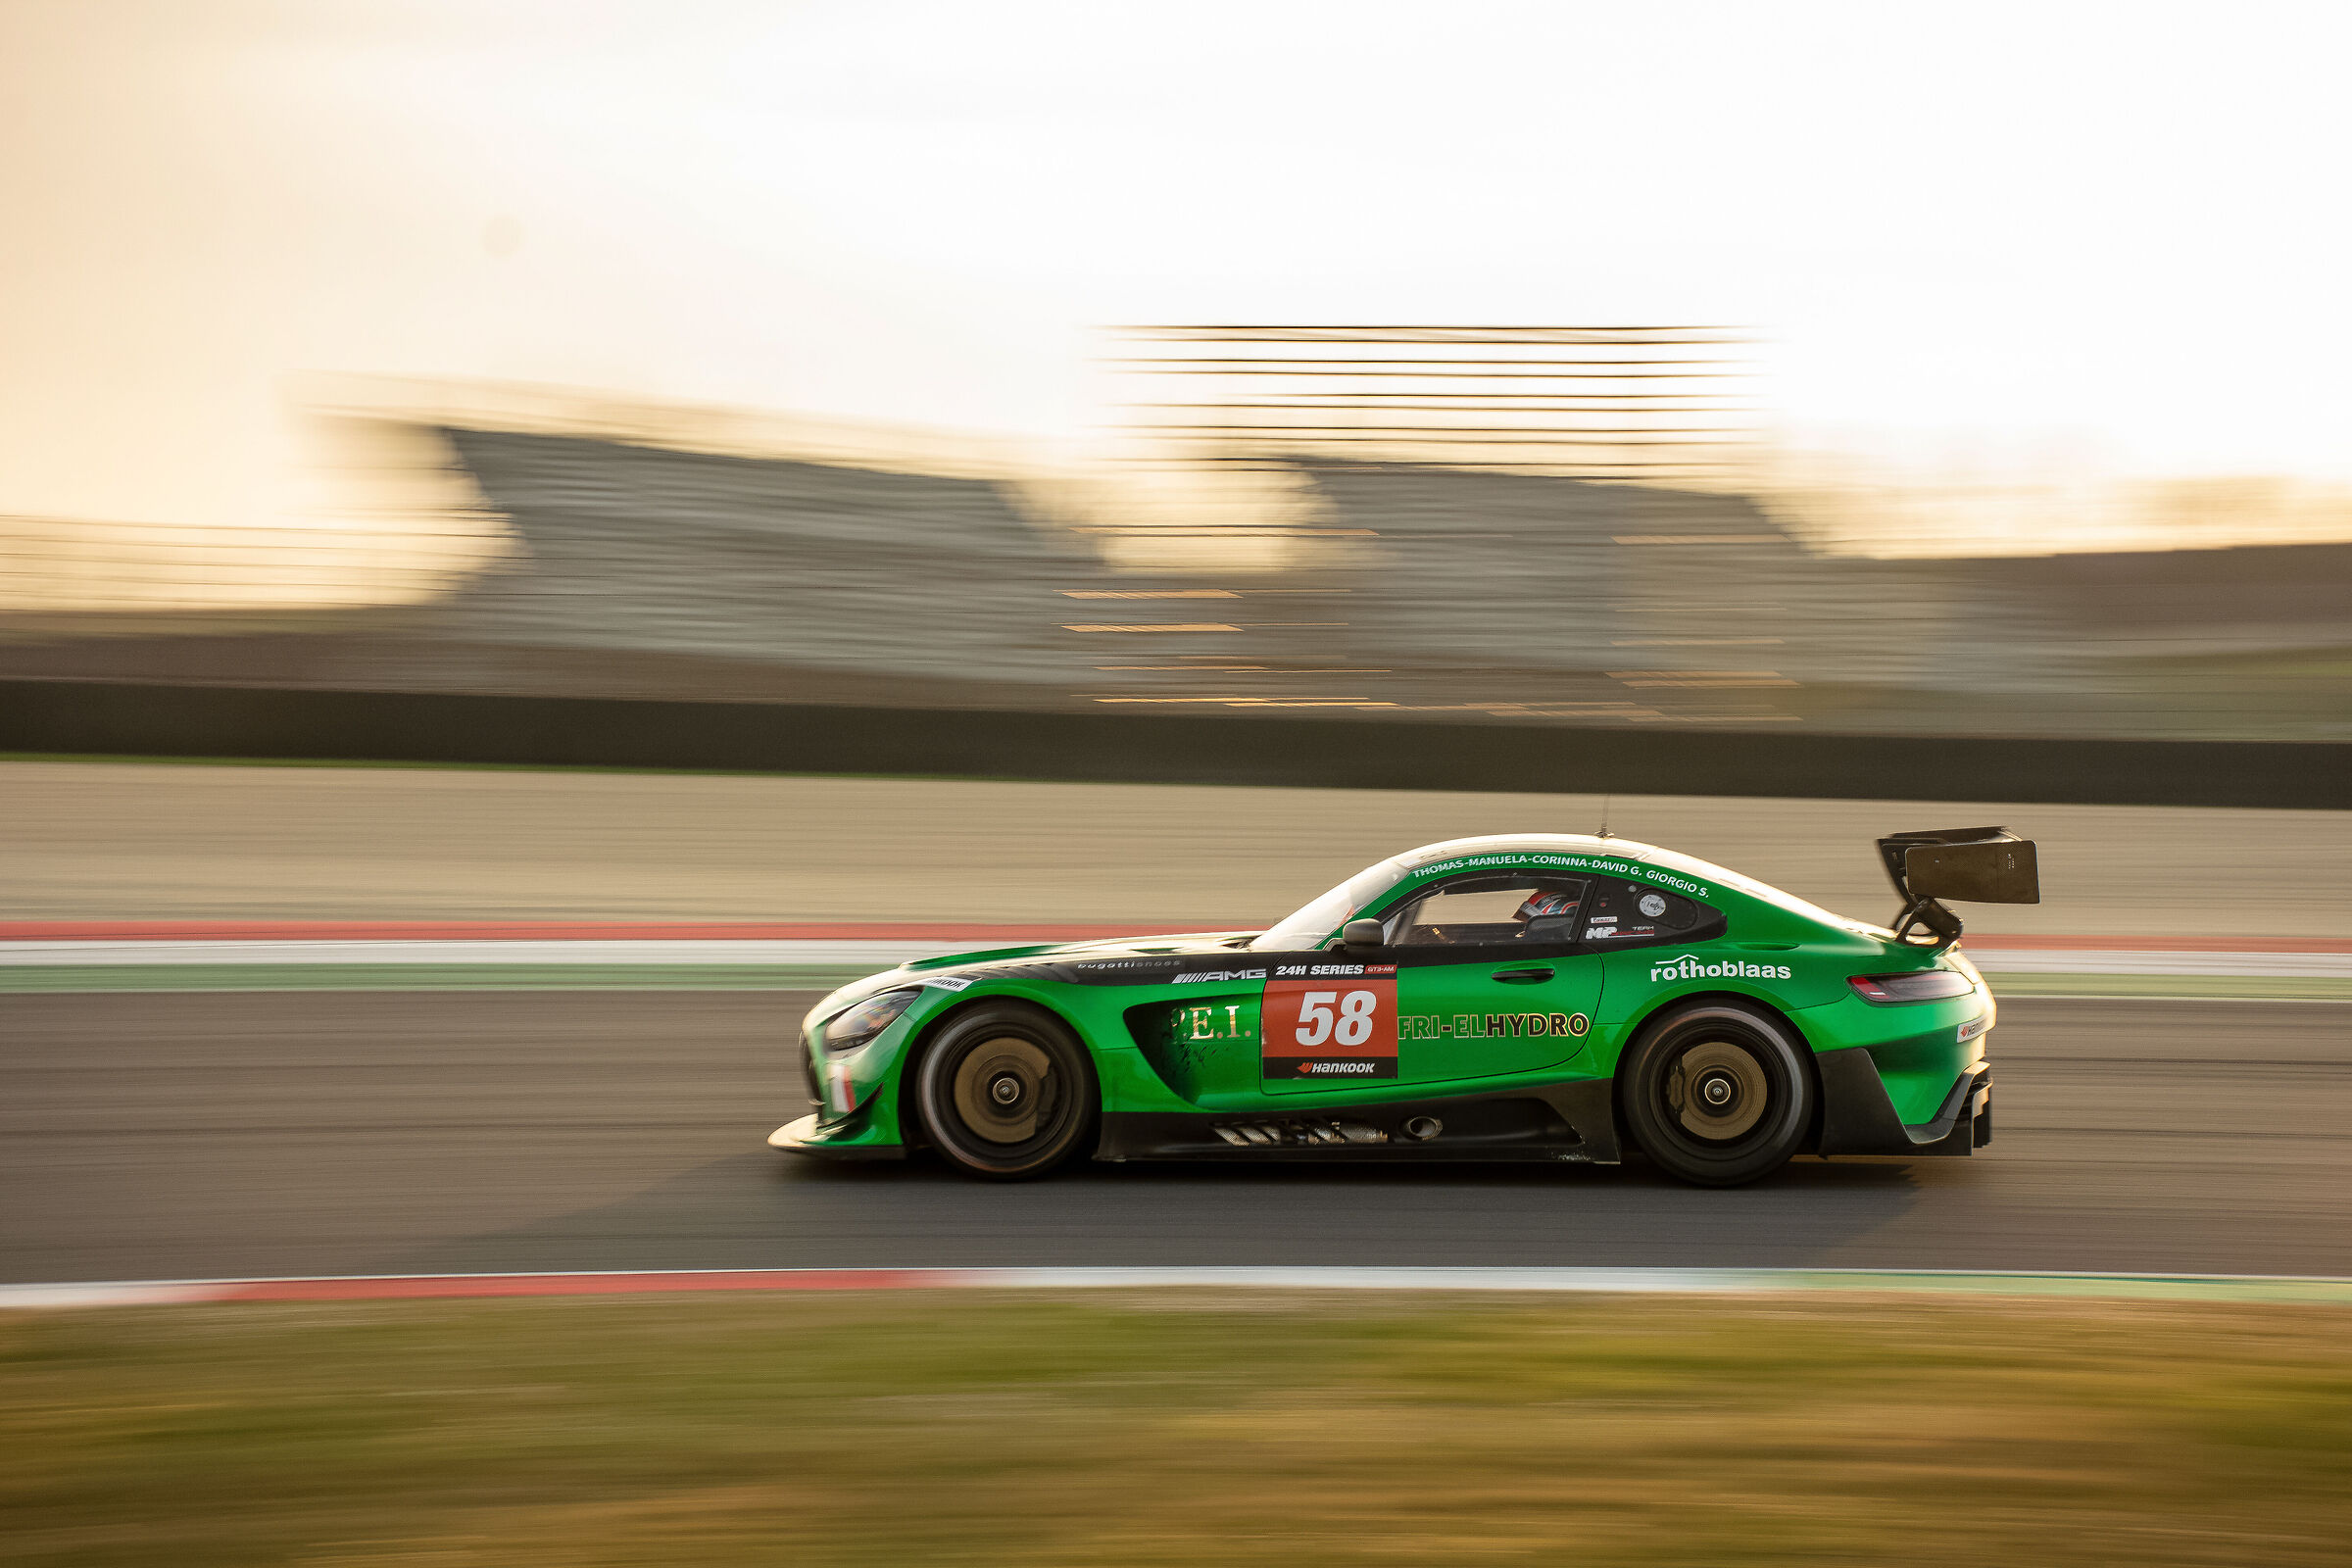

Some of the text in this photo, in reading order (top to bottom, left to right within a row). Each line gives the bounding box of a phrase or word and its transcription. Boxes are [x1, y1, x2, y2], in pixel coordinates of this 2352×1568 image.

[1645, 869, 1697, 893] GIORGIO
[1697, 887, 1710, 898] S.
[1201, 968, 1267, 983] AMG
[1275, 965, 1307, 976] 24H
[1310, 964, 1365, 976] SERIES
[1650, 960, 1792, 982] rothoblaas
[1295, 990, 1377, 1047] 58
